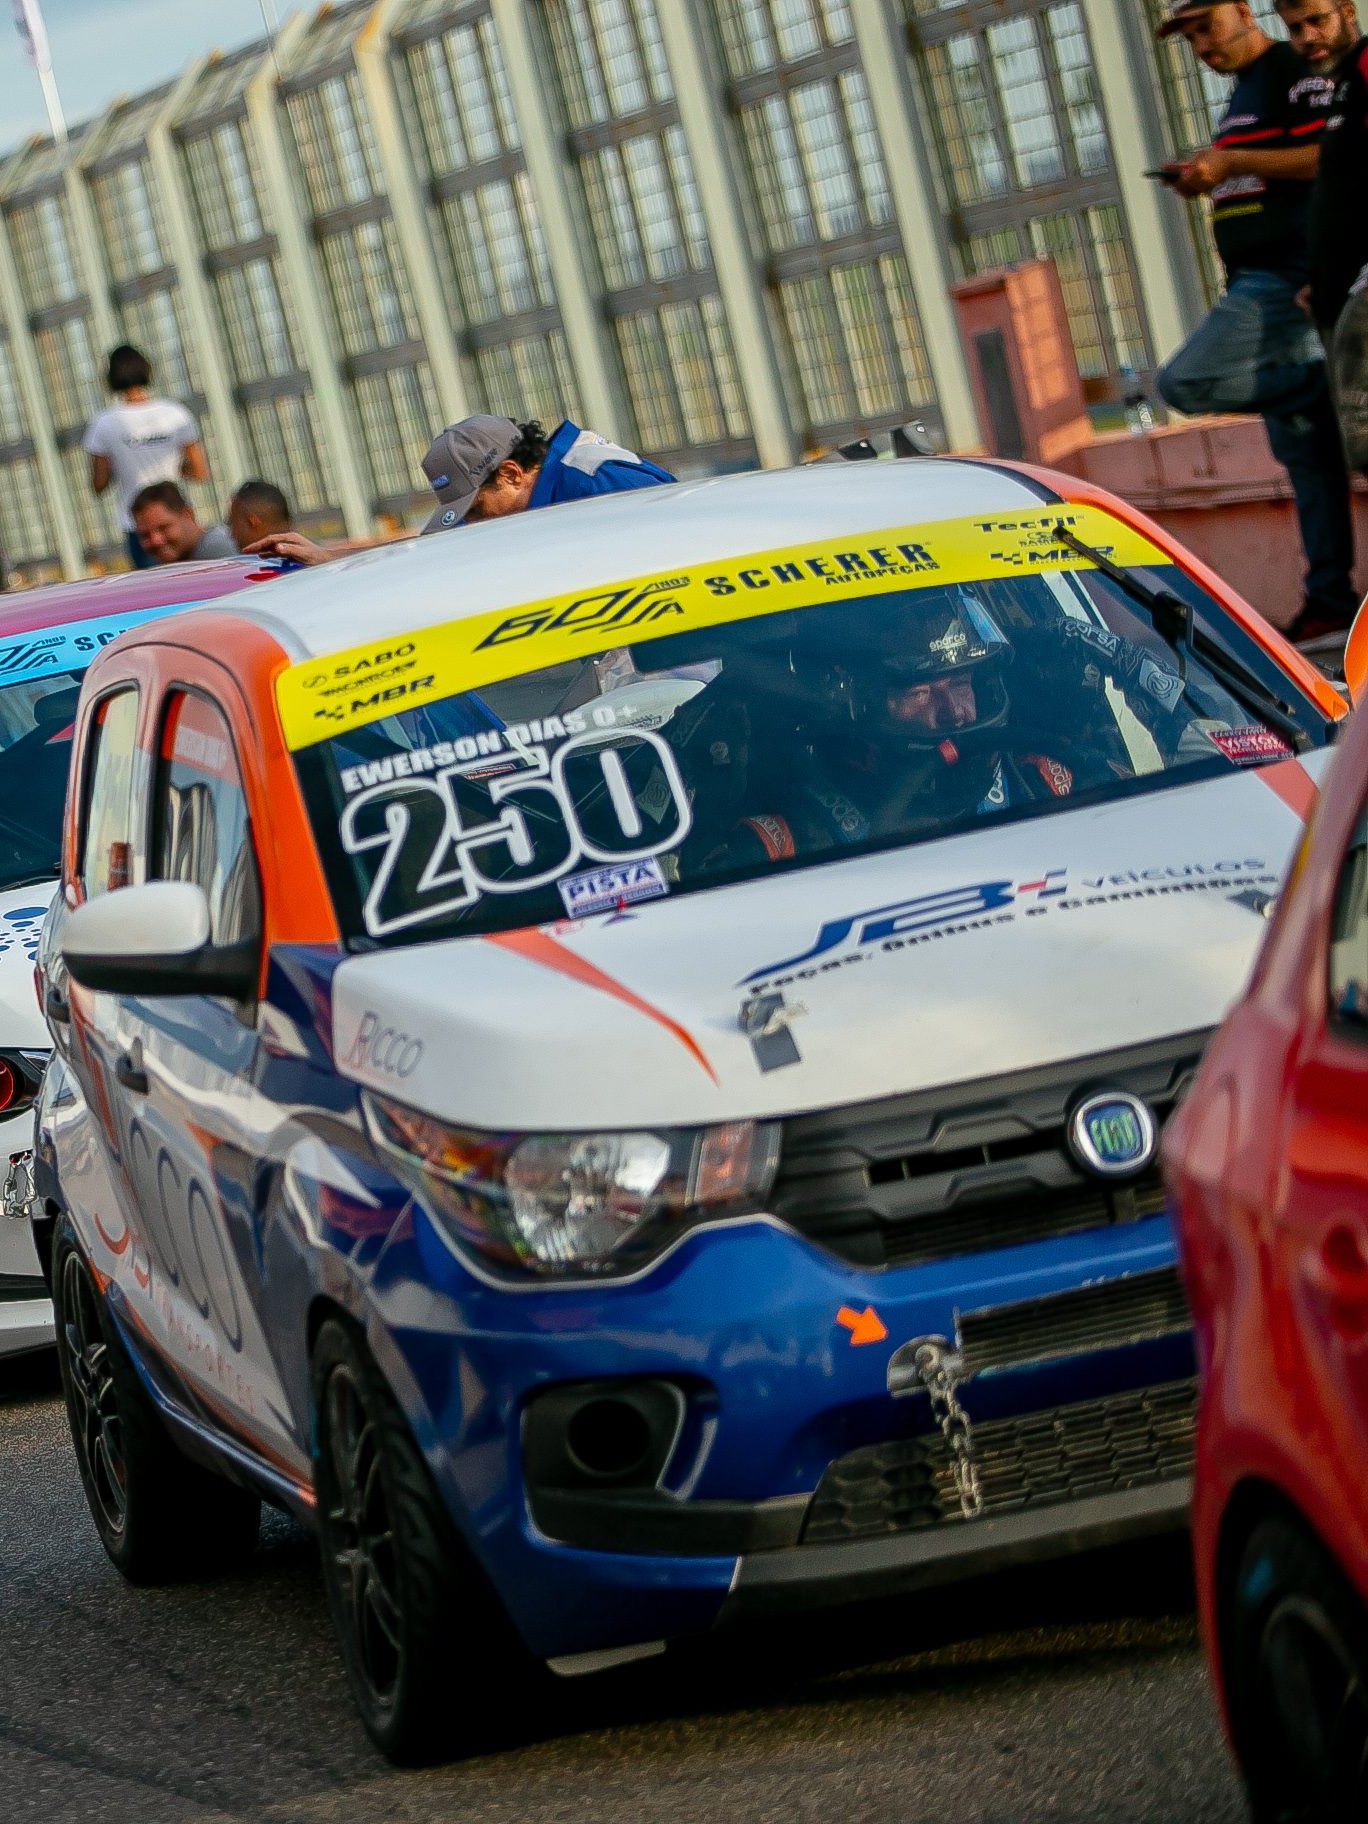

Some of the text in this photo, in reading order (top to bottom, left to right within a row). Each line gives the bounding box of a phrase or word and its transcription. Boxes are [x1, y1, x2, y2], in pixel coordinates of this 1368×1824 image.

[703, 543, 934, 597] SCHERER
[351, 674, 435, 713] MBR
[340, 729, 502, 794] EWERSON
[507, 712, 588, 745] DIAS
[339, 727, 693, 938] 250
[568, 866, 655, 900] PISTA
